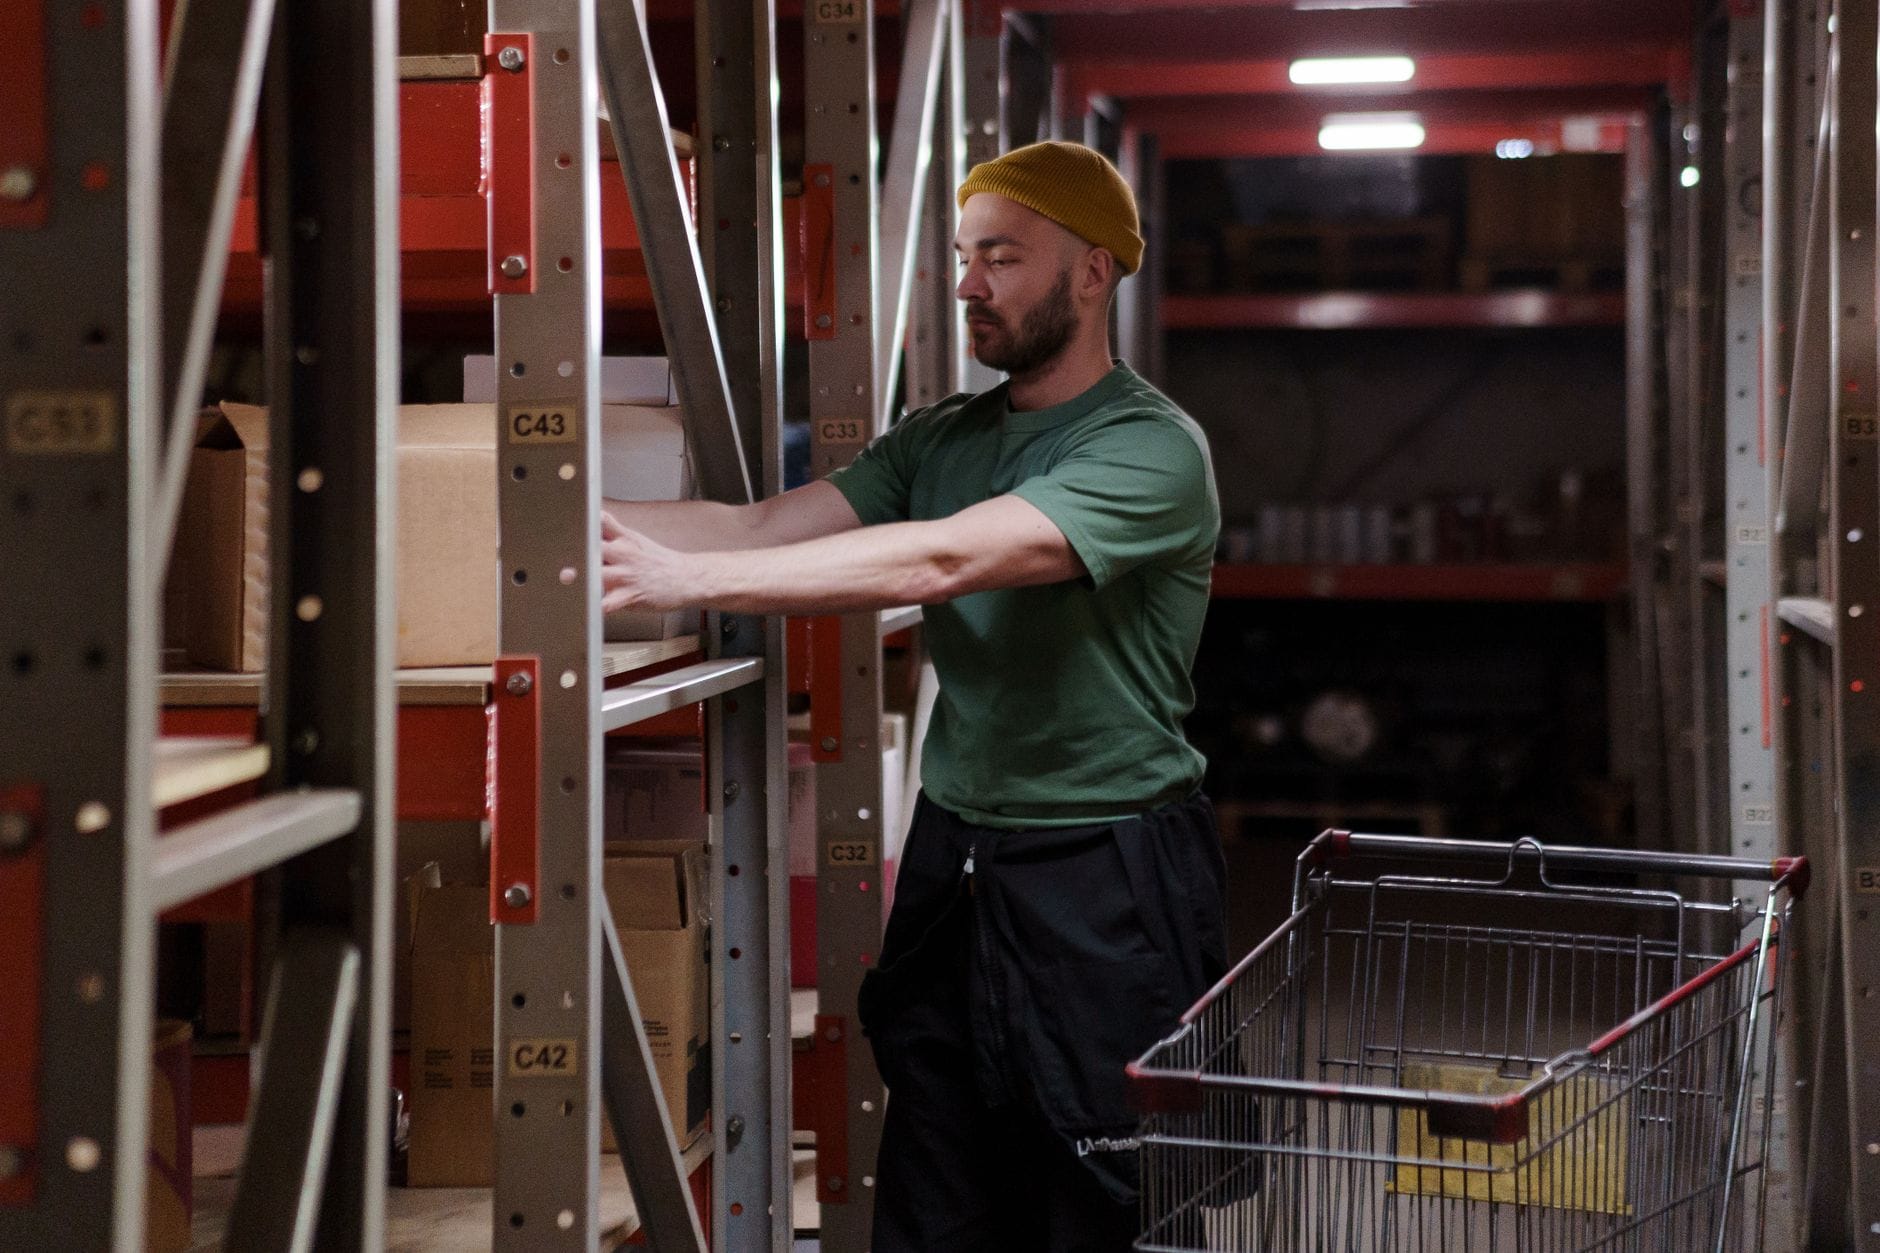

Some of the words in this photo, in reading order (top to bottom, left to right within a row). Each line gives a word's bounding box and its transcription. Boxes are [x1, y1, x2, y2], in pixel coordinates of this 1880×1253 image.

[819, 2, 854, 19] C34
[514, 413, 565, 437] C43
[822, 423, 858, 439] C33
[831, 845, 866, 861] C32
[515, 1045, 567, 1070] C42
